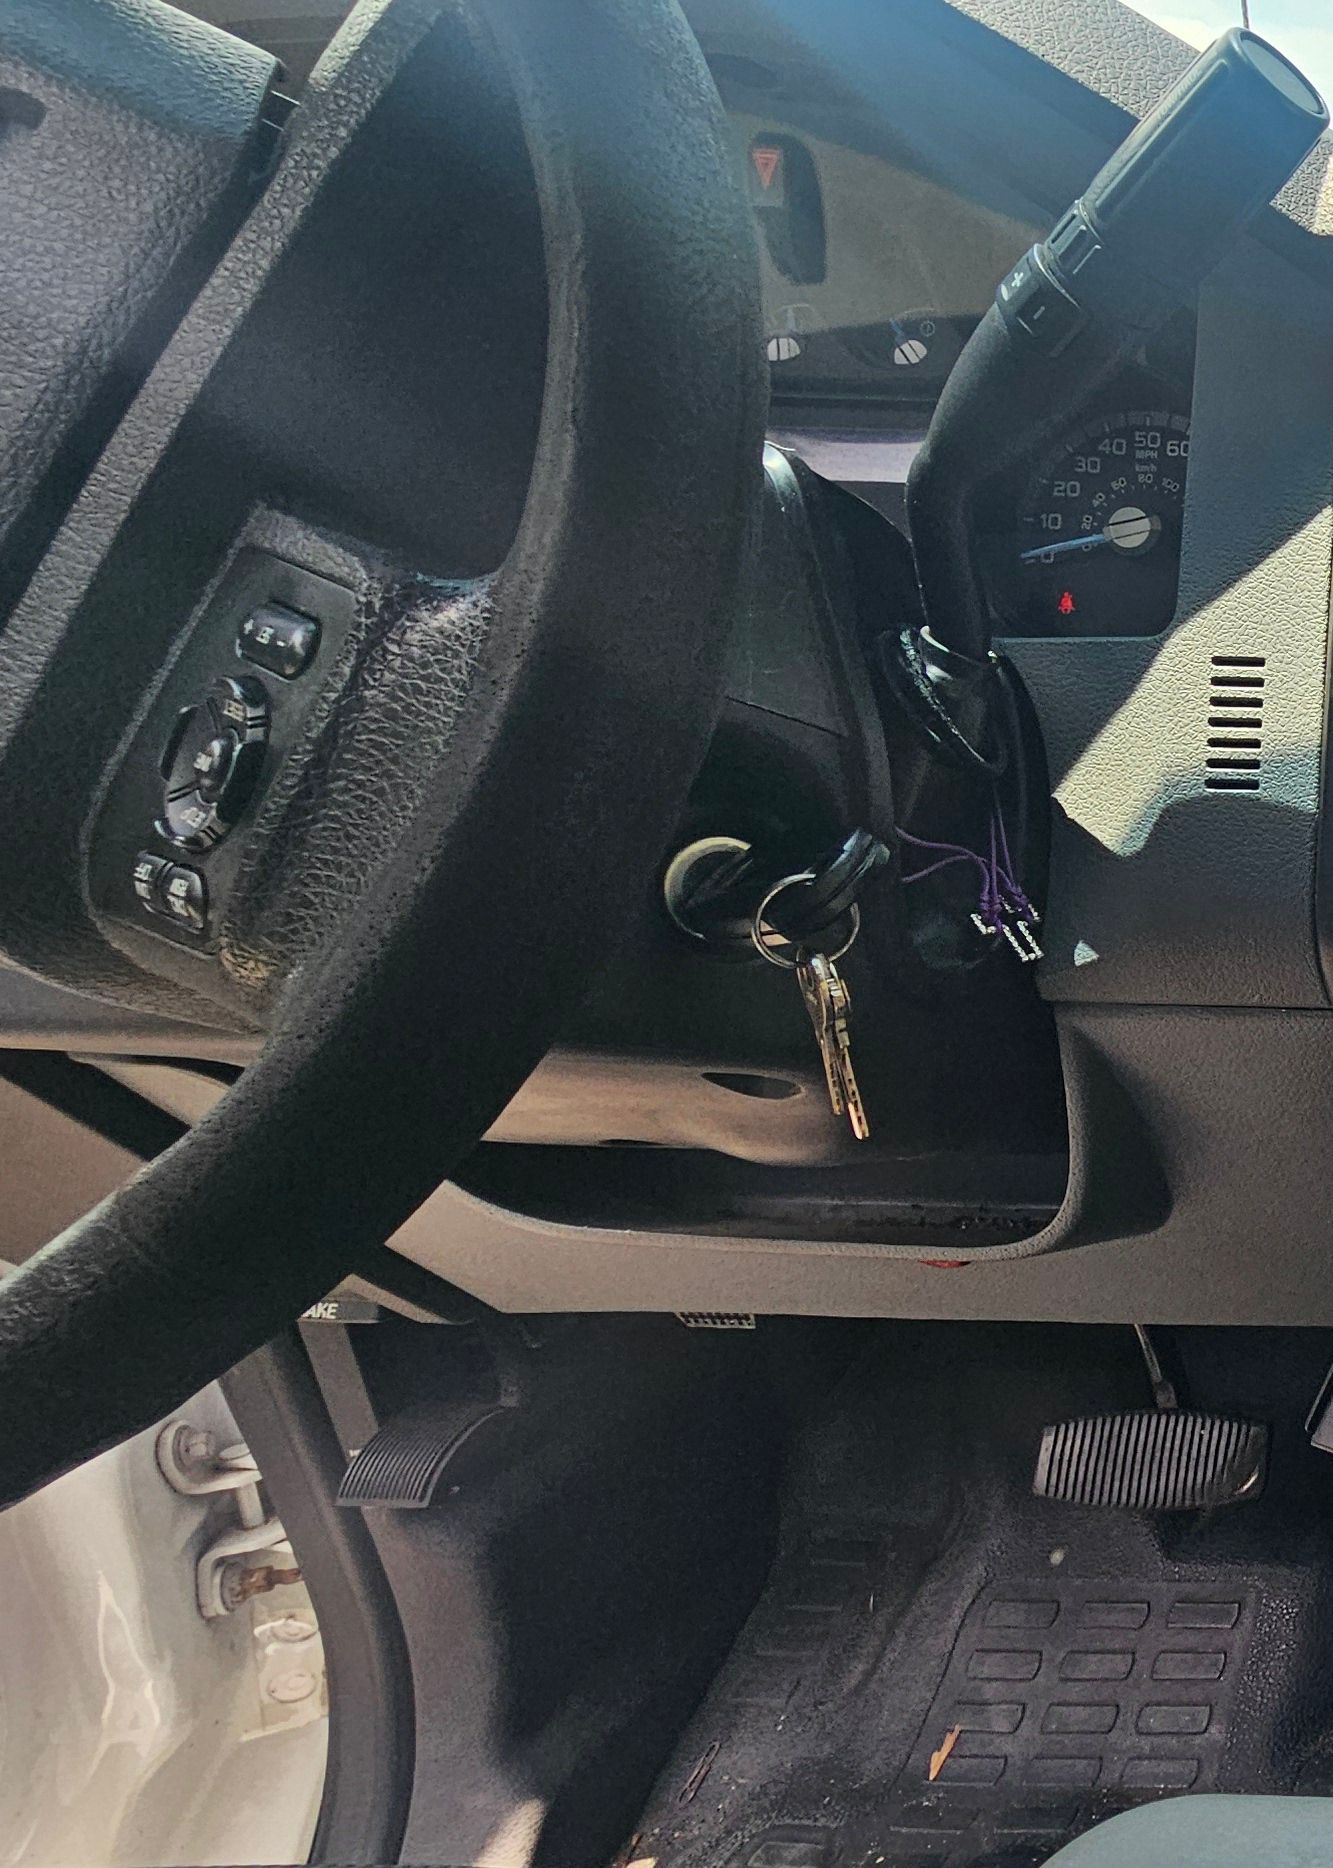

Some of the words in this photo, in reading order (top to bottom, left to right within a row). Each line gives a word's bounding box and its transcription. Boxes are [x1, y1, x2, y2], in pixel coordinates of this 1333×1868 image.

[1099, 438, 1127, 455] 40
[1134, 432, 1161, 448] 50
[1135, 450, 1158, 459] MPH
[1075, 457, 1100, 473] 30
[1053, 481, 1080, 497] 20
[1040, 513, 1062, 530] 10
[301, 1302, 339, 1319] AKE
